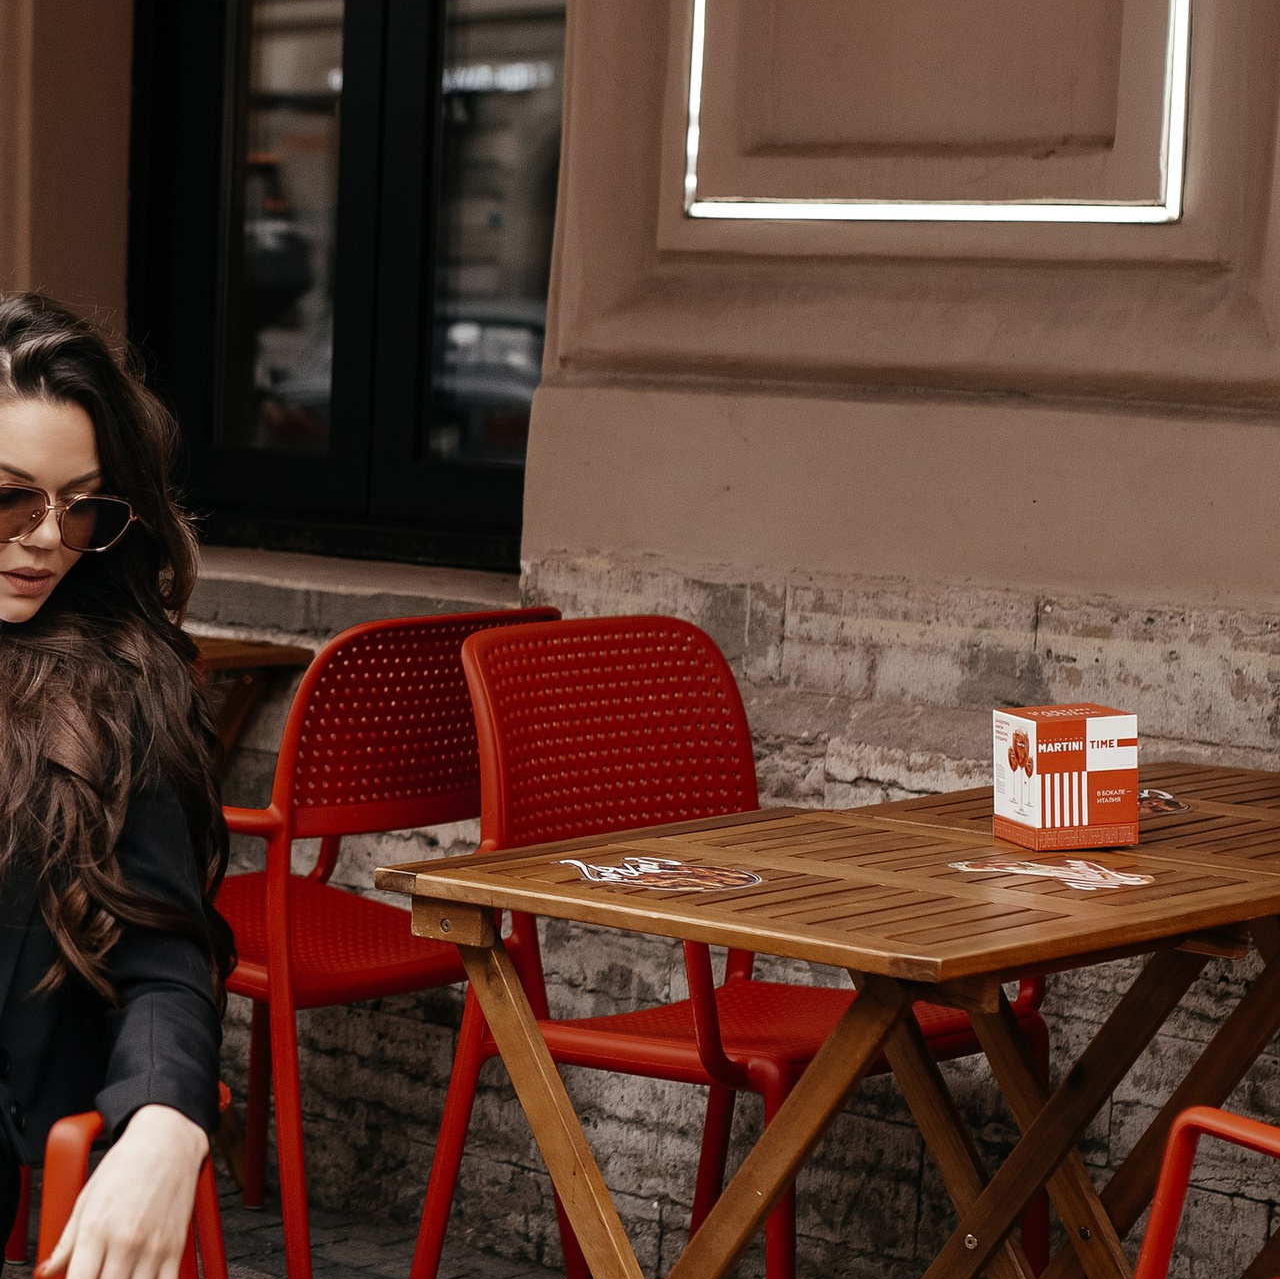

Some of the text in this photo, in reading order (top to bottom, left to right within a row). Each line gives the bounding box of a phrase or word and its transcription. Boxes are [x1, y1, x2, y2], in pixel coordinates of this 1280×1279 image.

[1038, 741, 1083, 753] MARTINI
[1089, 739, 1115, 749] TIME
[1102, 788, 1125, 796] БОКАЛЕ
[1096, 796, 1121, 804] ИТАЛИЯ
